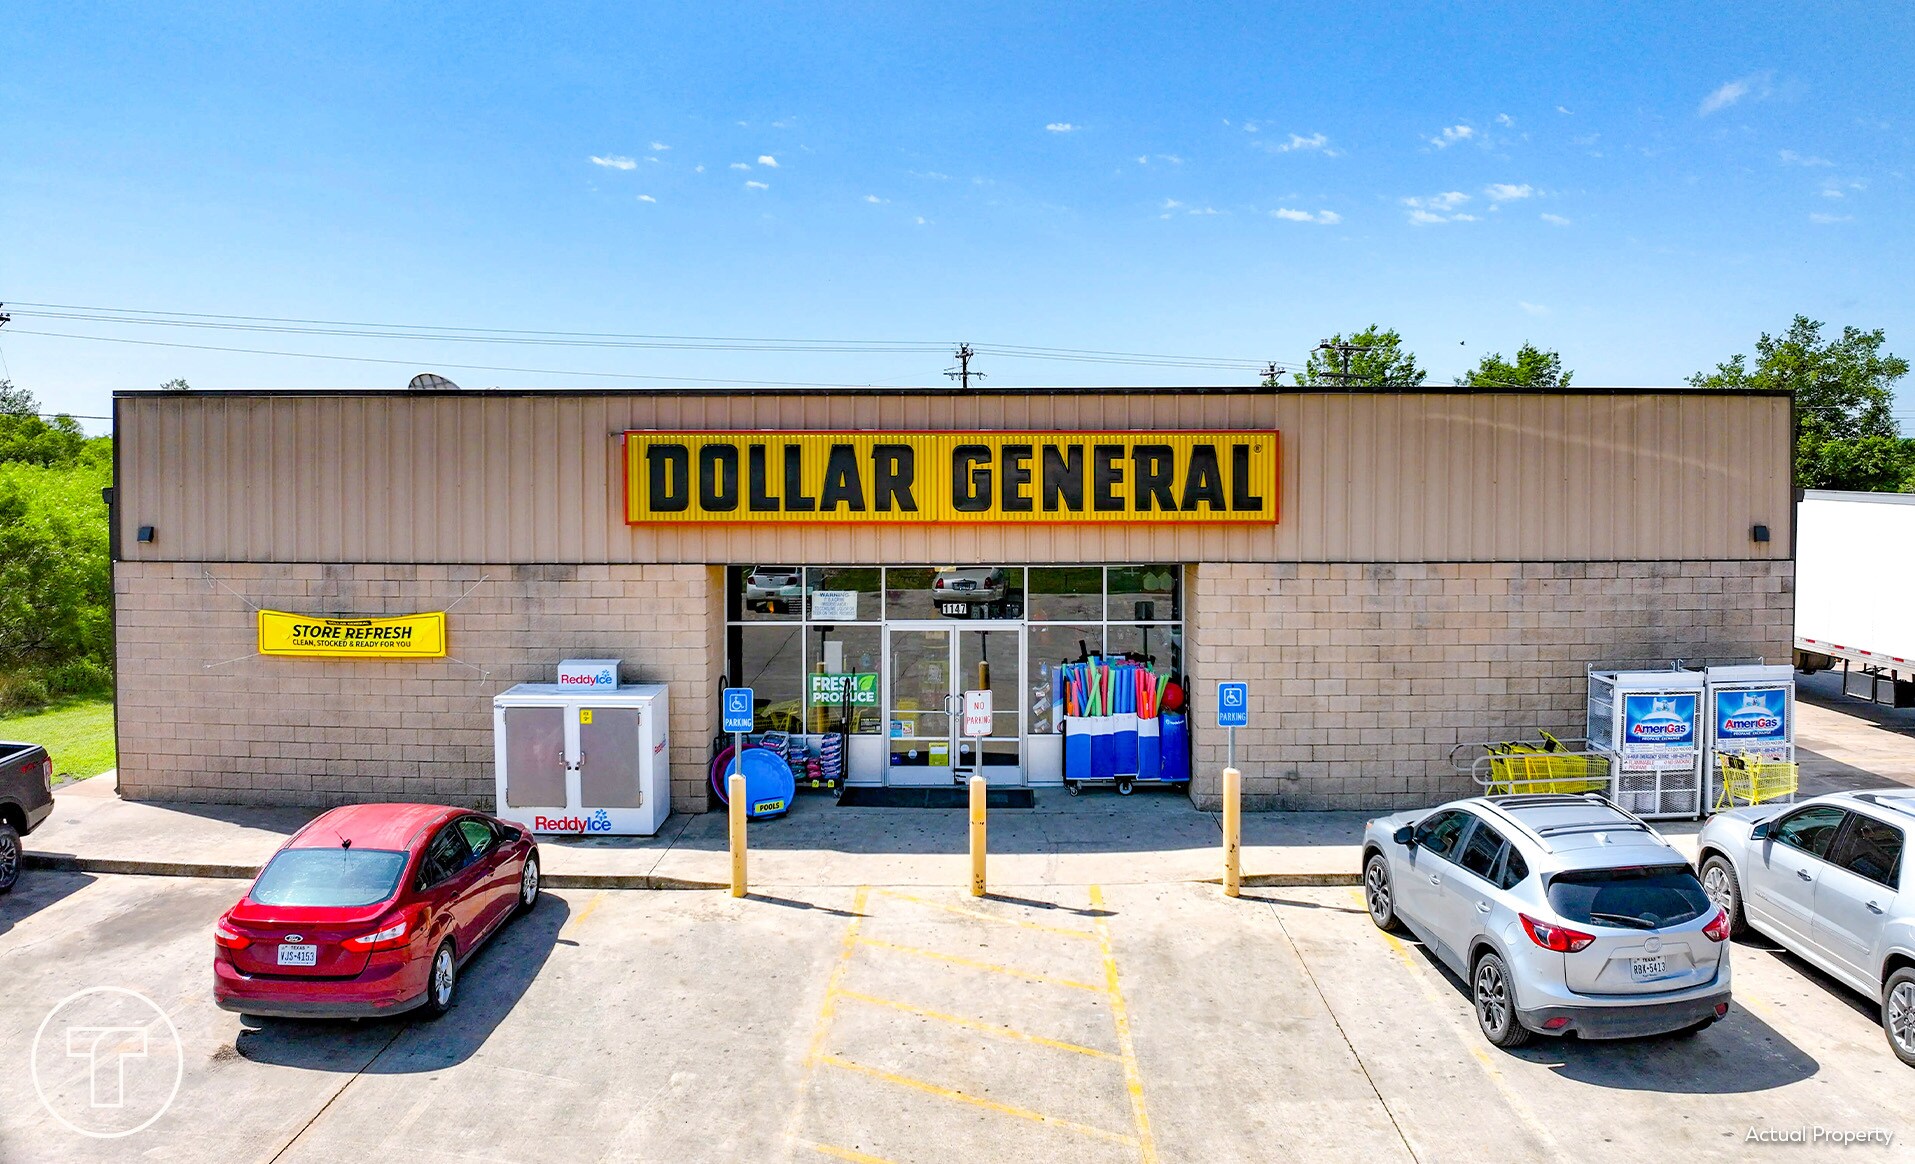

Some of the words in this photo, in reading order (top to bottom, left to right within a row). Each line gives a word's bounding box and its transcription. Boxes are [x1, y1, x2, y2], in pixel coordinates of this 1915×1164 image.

[646, 443, 918, 512] DOLLAR
[951, 443, 1263, 512] GENERAL
[944, 604, 966, 613] 1147
[293, 624, 340, 638] STORE
[344, 626, 412, 639] REFRESH
[293, 639, 316, 647] CLEAN,
[355, 640, 378, 648] READY
[813, 677, 857, 690] FRESH
[974, 702, 984, 710] NO
[1220, 713, 1246, 721] PARKING
[726, 718, 751, 727] PARKING
[1725, 719, 1777, 729] AmeriGas
[1634, 724, 1686, 733] AmeriGas
[760, 802, 779, 811] POOLS
